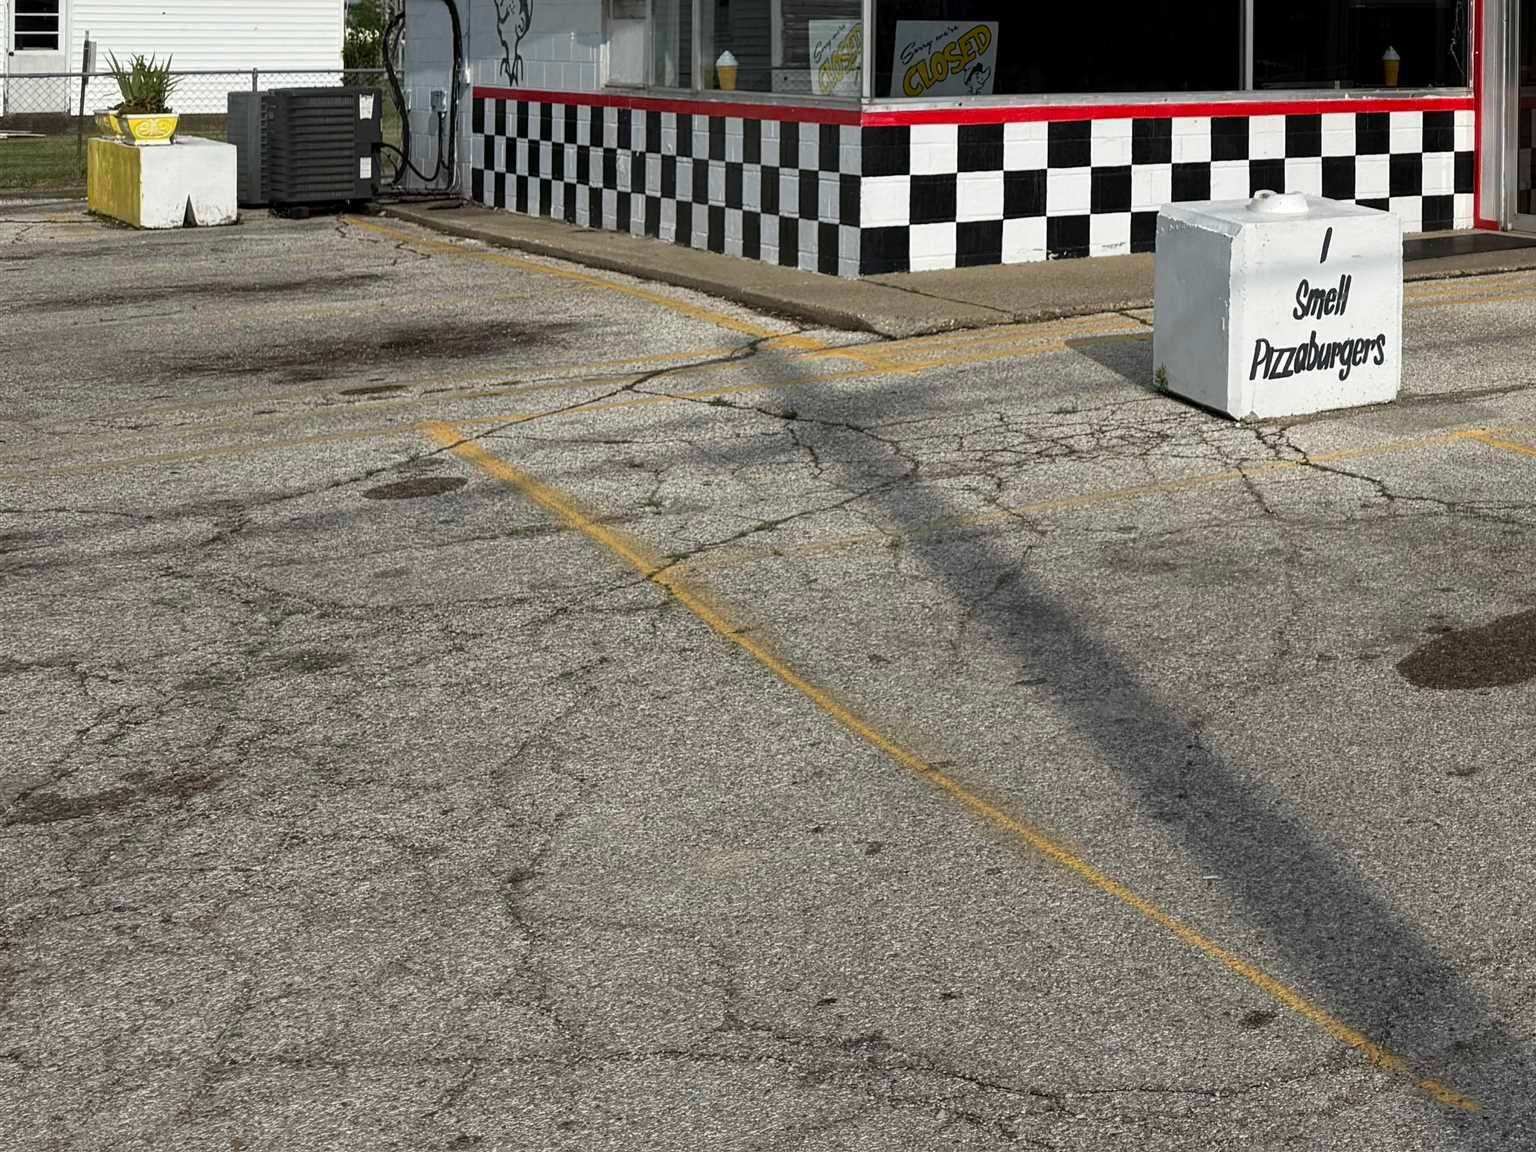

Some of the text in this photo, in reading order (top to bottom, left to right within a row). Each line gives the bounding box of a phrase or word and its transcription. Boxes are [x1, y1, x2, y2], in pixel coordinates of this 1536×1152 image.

[899, 41, 933, 65] Sorry
[902, 24, 992, 97] CLOSED
[1319, 226, 1333, 264] I
[1292, 273, 1353, 321] Smell
